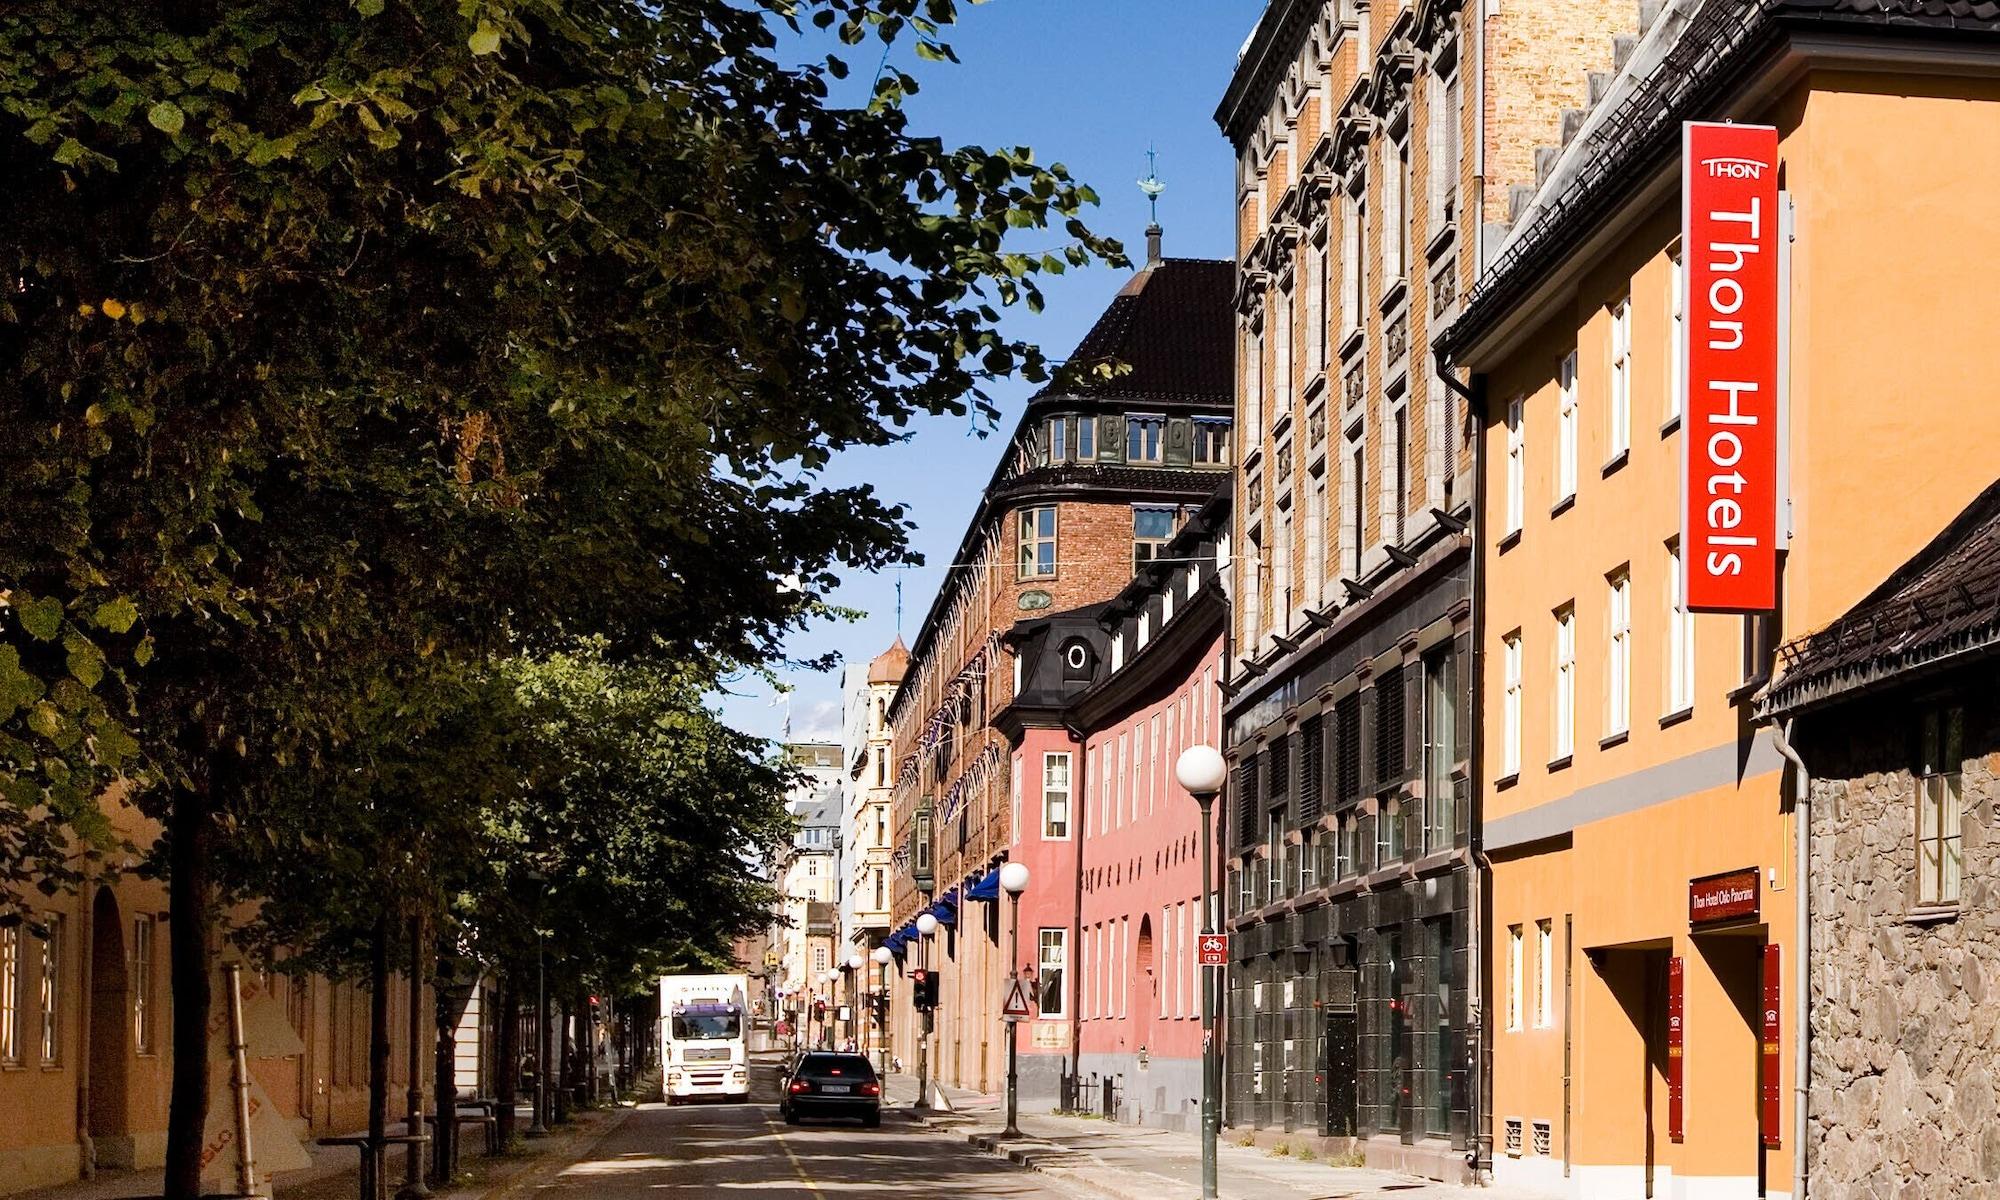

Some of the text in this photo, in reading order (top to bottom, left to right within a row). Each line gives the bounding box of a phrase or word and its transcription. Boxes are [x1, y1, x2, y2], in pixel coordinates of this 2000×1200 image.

[1701, 157, 1769, 179] THON
[1706, 197, 1760, 576] Thon Hotels
[1693, 894, 1706, 909] Thon
[1705, 891, 1719, 907] Hotel
[1730, 888, 1754, 903] Panorama
